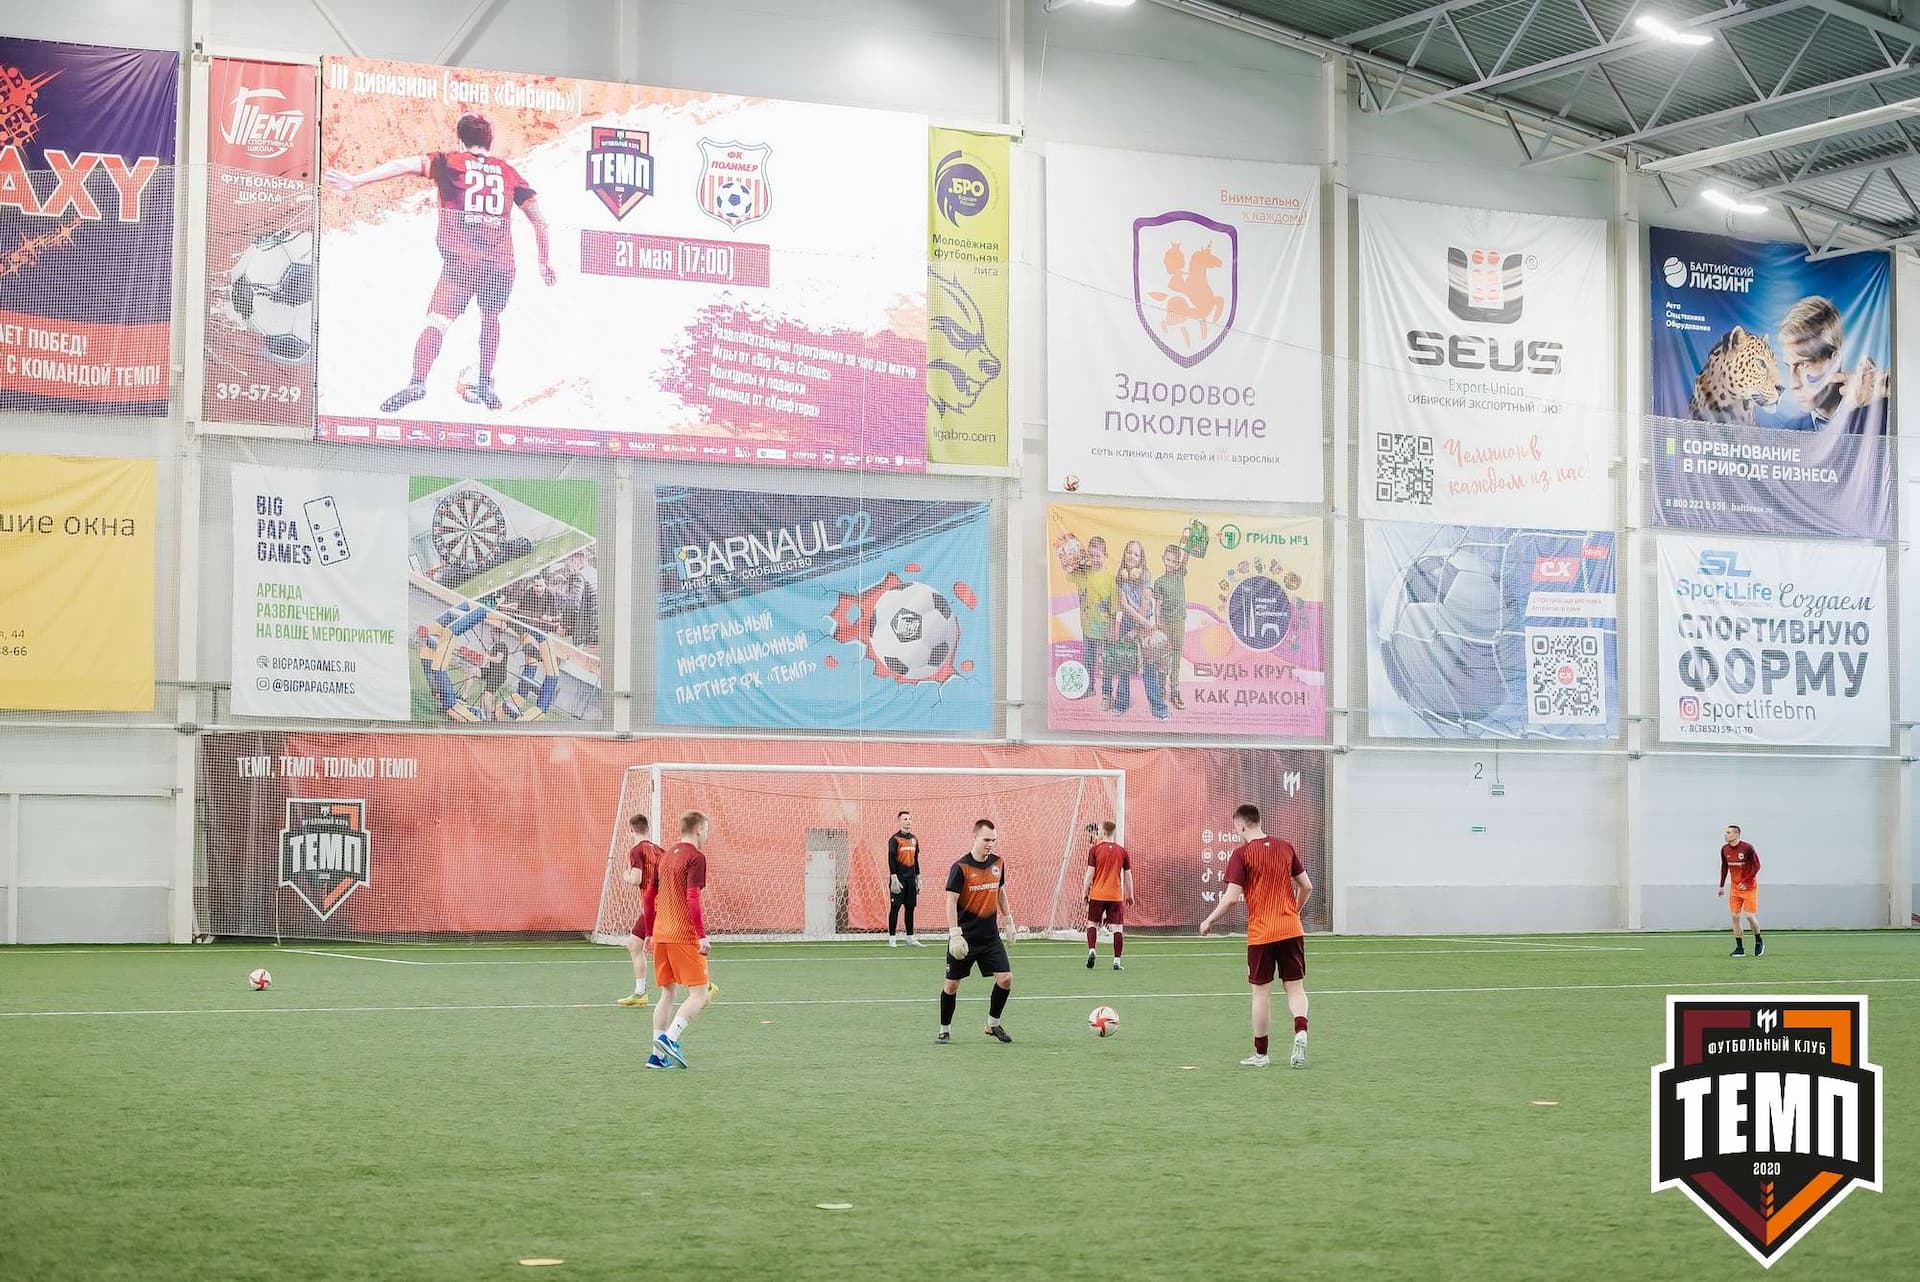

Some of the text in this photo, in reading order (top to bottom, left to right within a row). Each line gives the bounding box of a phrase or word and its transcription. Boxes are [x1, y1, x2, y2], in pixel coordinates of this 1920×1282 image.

[353, 71, 438, 99] дивизион
[727, 151, 743, 160] ФК
[591, 152, 651, 190] ТЕМП
[711, 161, 759, 173] ПОЛИМЕР
[221, 174, 305, 190] ФУТБОЛЬНАЯ
[464, 170, 505, 216] 23
[239, 190, 283, 203] ШКОЛА
[1220, 189, 1300, 208] Внимательно
[932, 233, 999, 251] Молодёжная
[616, 240, 634, 268] 21
[639, 247, 672, 271] мая
[934, 248, 999, 264] футбольная
[973, 267, 999, 277] лига
[1690, 261, 1754, 277] БАЛТИЙСКИЙ
[1689, 272, 1754, 293] ЛИЗИНГ
[1666, 301, 1681, 310] Авто
[28, 327, 87, 356] ПОБЕД!
[1406, 329, 1563, 375] SEUS
[7, 355, 160, 387] С КОМАНДОЙ ТЕМП!
[216, 383, 301, 402] 39-57-29
[1115, 372, 1256, 407] Здоровое
[1407, 393, 1466, 408] СИБИРСКИЙ
[1469, 399, 1535, 413] ЭКСПОРТНЫЙ
[933, 425, 996, 444] ligabro.com
[1105, 410, 1267, 439] поколение
[1091, 447, 1114, 457] сеть
[1116, 448, 1153, 460] клиник
[1155, 451, 1174, 462] для
[1177, 451, 1207, 463] детей
[1209, 453, 1215, 462] и
[1232, 453, 1280, 465] взрослых
[1444, 439, 1528, 468] Чемпион
[1683, 439, 1801, 462] СОРЕВНОВАНИЕ
[1449, 466, 1526, 496] каждом
[1531, 470, 1551, 491] из
[1683, 458, 1838, 483] В ПРИРОДЕ БИЗНЕСА
[256, 495, 283, 517] BIG
[64, 515, 135, 537] окна
[257, 519, 299, 541] PAPA
[1247, 533, 1286, 545] ГРИЛЬ
[257, 541, 312, 566] GAMES
[1697, 550, 1752, 577] SL
[256, 582, 303, 601] АРЕНДА
[1676, 578, 1773, 601] SportLife
[1779, 582, 1874, 618] Создаем
[256, 602, 340, 622] РАЗВЛЕЧЕНИЙ
[11, 629, 25, 638] 44
[256, 623, 395, 645] НА ВАШЕ МЕРОПРИЯТИЕ
[676, 609, 773, 646] ГЕНЕРАЛЬНЫЙ
[1678, 613, 1870, 645] СПОРТИВНУЮ
[676, 630, 808, 676] ИНФОРМАЦИОННЫЙ
[272, 657, 356, 673] BIGPAPAGAMES.RU
[1193, 663, 1249, 680] БУДЬ
[1678, 646, 1869, 698] ФОРМУ
[272, 678, 356, 694] @BIGPAPAGAMES
[675, 676, 737, 704] ПАРТНЕР
[740, 671, 763, 689] ФК
[1194, 688, 1311, 707] КАК ДРАКОН!
[1702, 699, 1816, 722] sportlifebrn
[237, 756, 417, 780] ТЕМП, ТЕМП, ТОЛЬКО ТЕМП!
[1474, 762, 1483, 779] 2
[289, 833, 362, 874] ТЕМП
